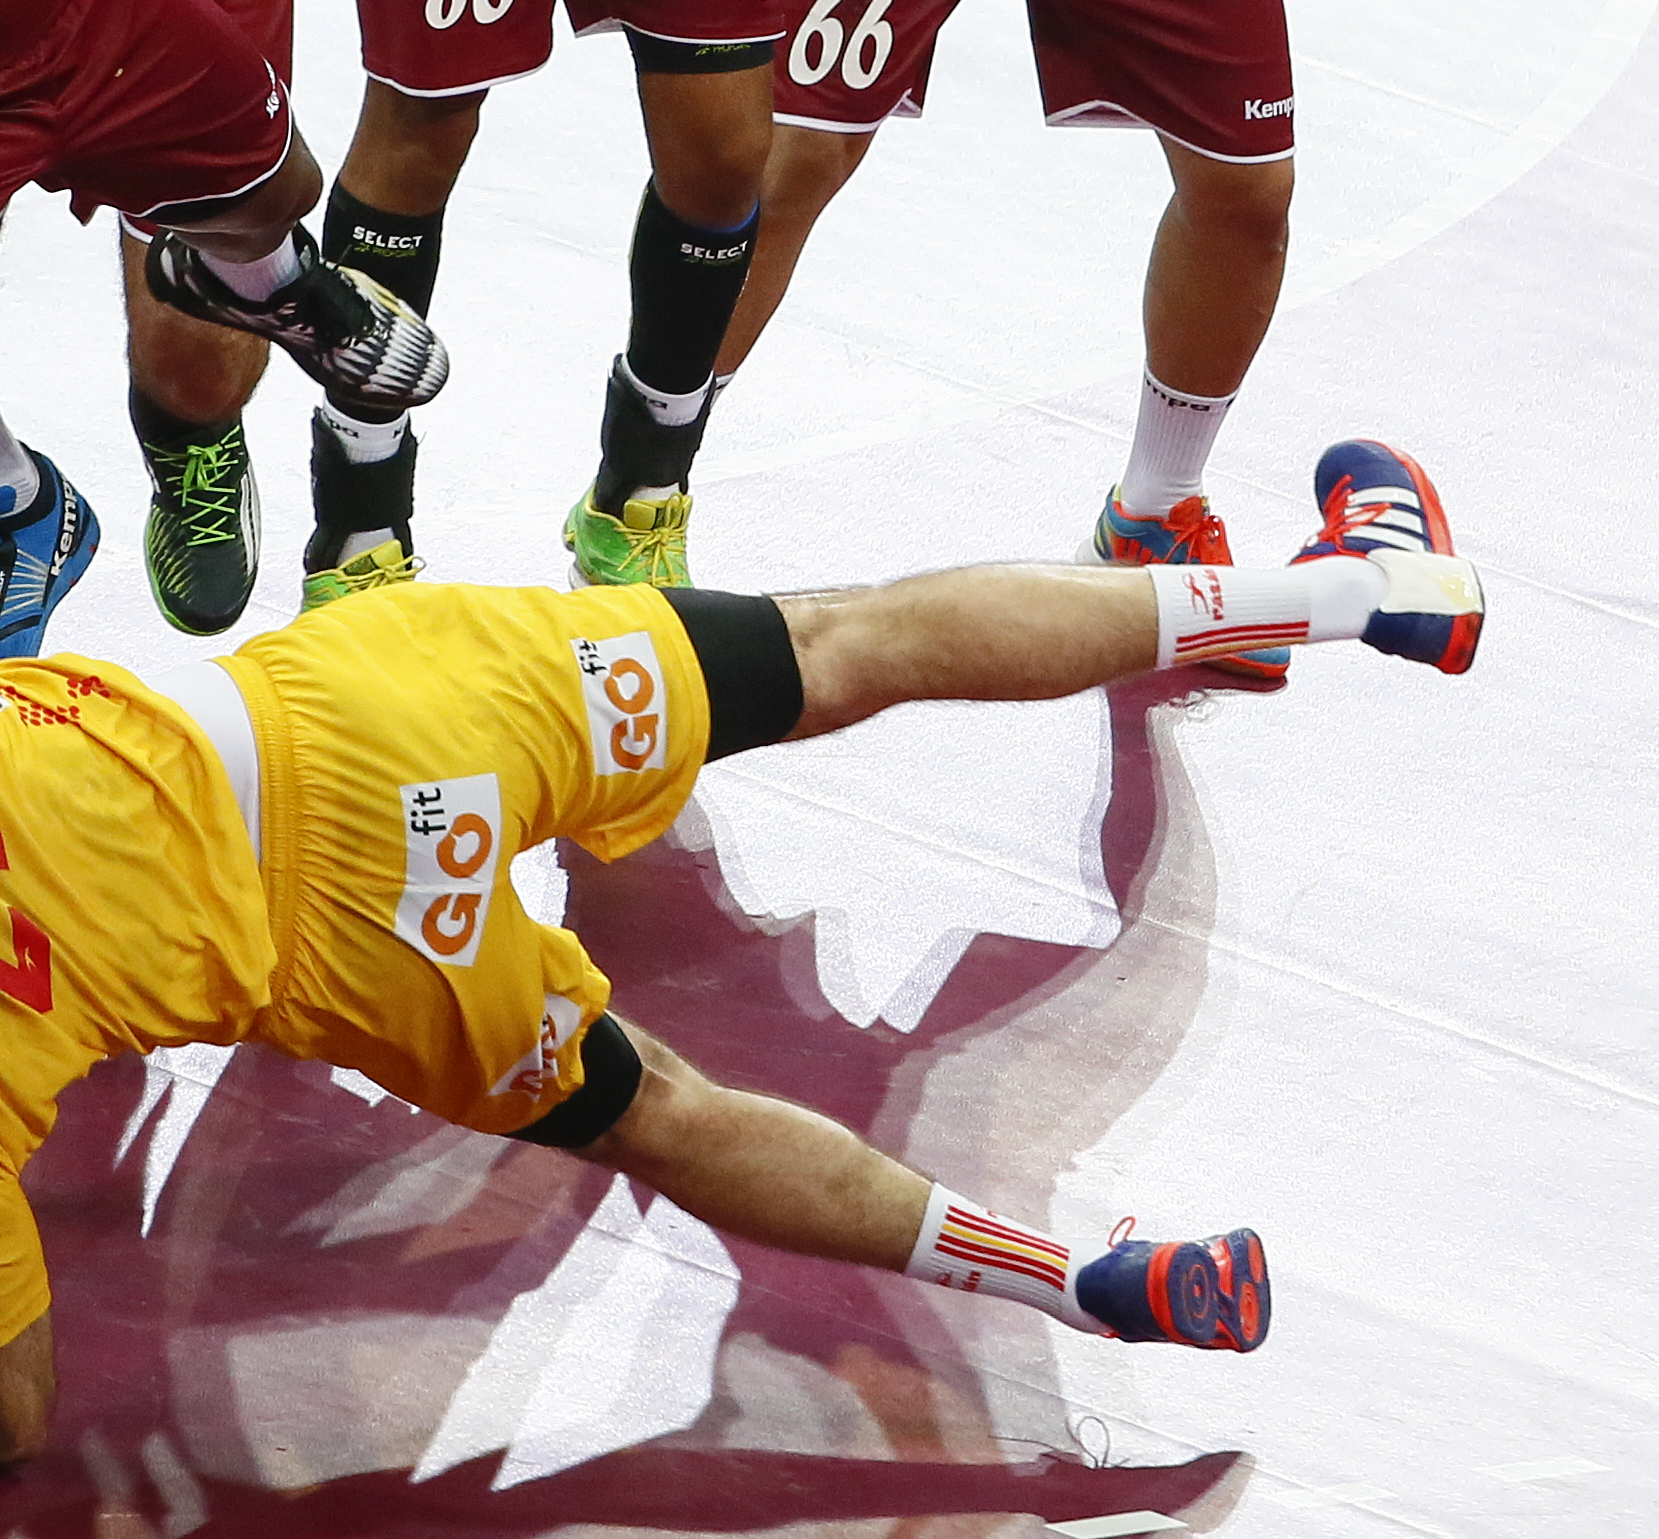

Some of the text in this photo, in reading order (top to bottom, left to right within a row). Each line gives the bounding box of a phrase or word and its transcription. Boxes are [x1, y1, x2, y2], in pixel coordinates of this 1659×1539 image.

[1244, 95, 1294, 121] Kemp
[352, 225, 424, 250] SELECT
[679, 239, 749, 260] SELECT
[50, 479, 81, 577] Kemp
[579, 639, 609, 676] fit
[603, 657, 659, 770] GO
[410, 786, 447, 837] fit
[420, 812, 493, 957] GO
